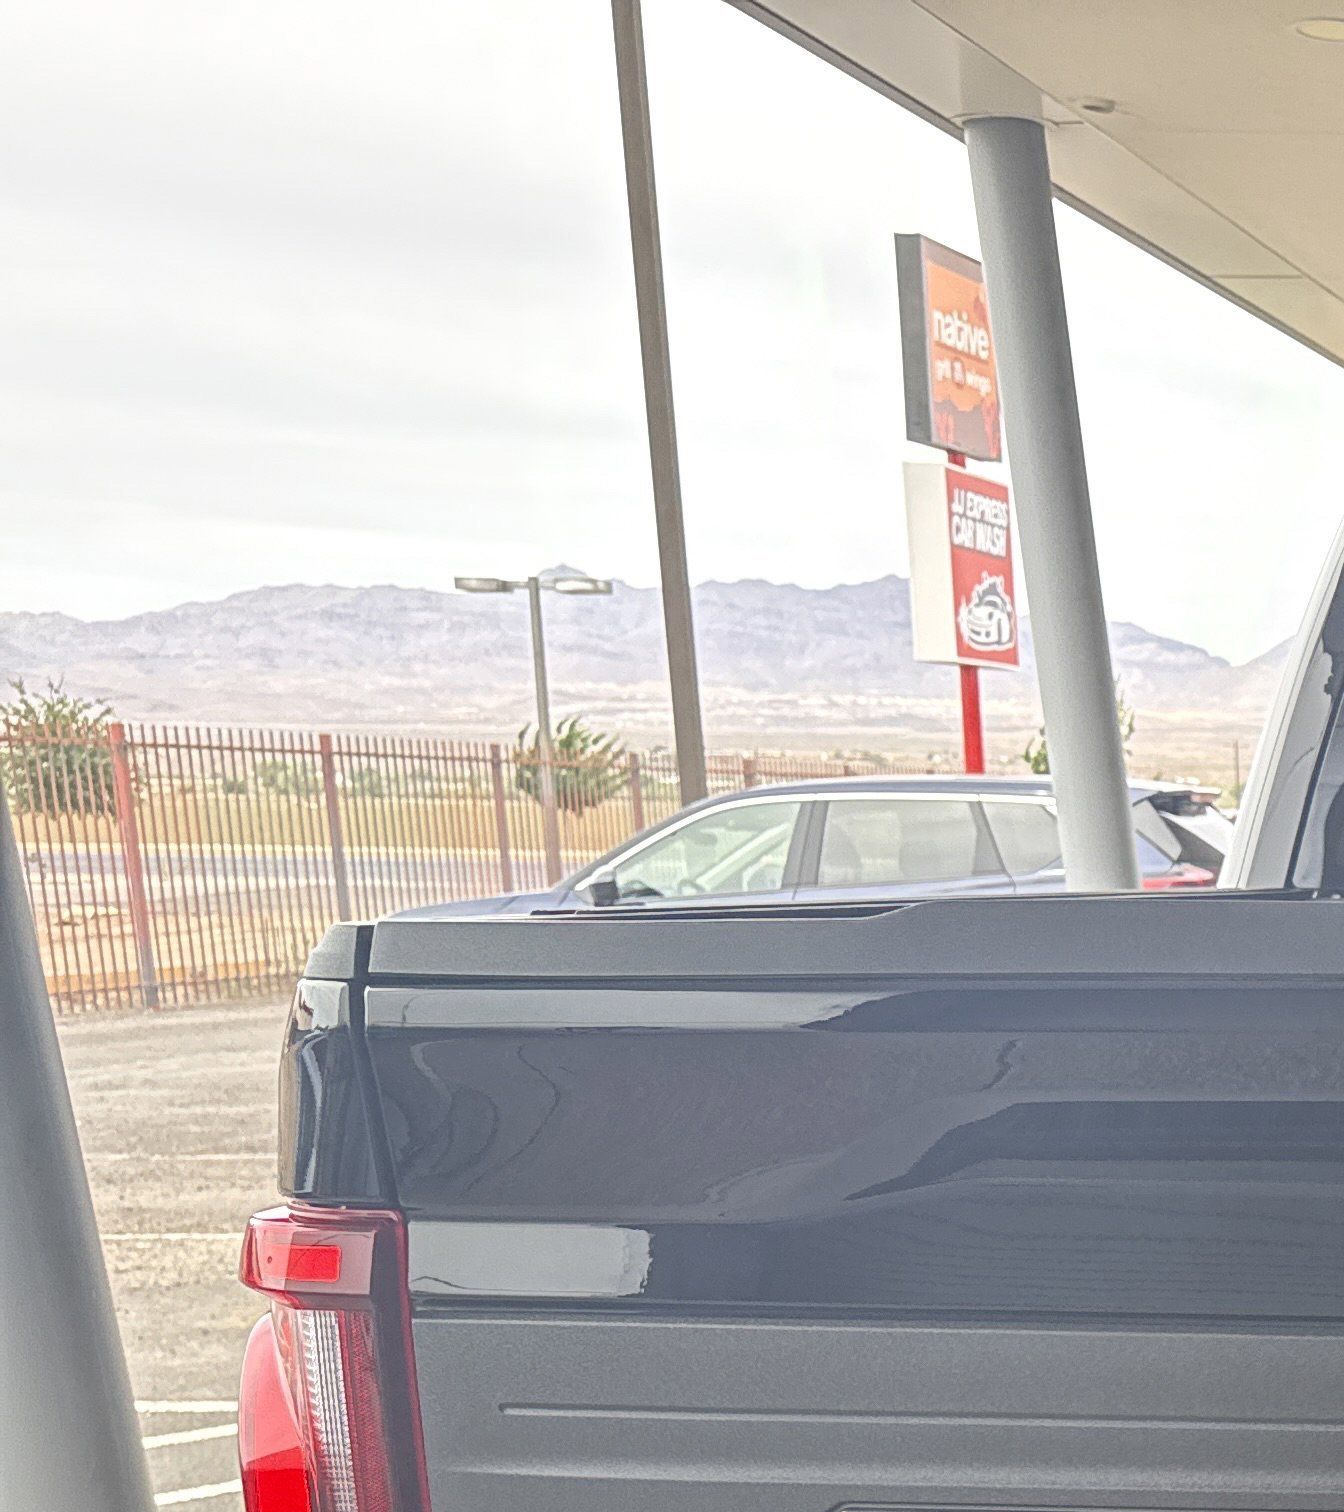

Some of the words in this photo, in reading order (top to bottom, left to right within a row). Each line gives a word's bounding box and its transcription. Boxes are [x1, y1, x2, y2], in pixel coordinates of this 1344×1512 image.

[934, 311, 989, 360] native
[951, 487, 964, 515] JJ
[966, 491, 1008, 527] EXPRESS
[951, 514, 975, 548] CAR
[975, 521, 1006, 557] WASH
